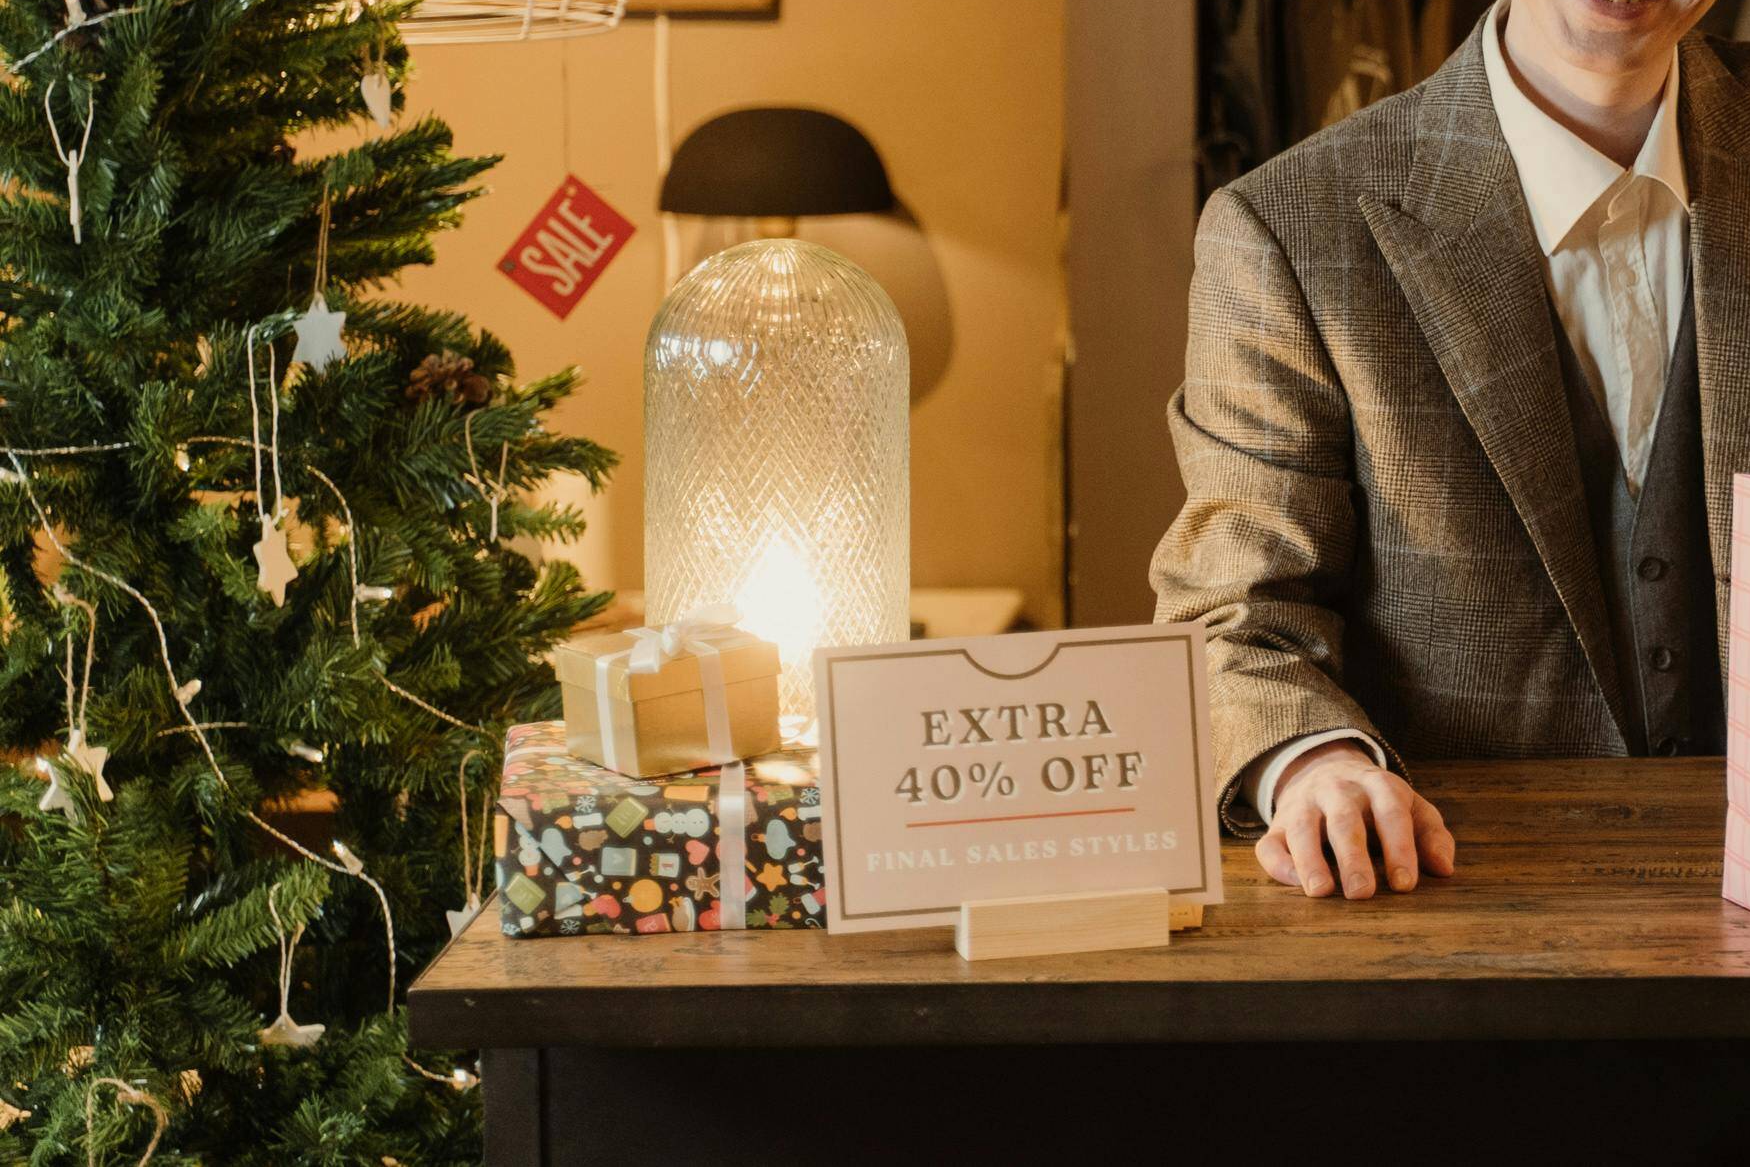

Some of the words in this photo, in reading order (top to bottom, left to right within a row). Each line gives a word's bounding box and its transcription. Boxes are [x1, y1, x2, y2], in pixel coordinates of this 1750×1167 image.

[519, 197, 615, 297] SALE
[920, 700, 1115, 749] EXTRA
[894, 760, 1018, 805] 40%
[1040, 751, 1145, 795] OFF
[865, 847, 956, 872] FINAL
[966, 837, 1058, 864] SALES
[1068, 831, 1178, 857] STYLES
